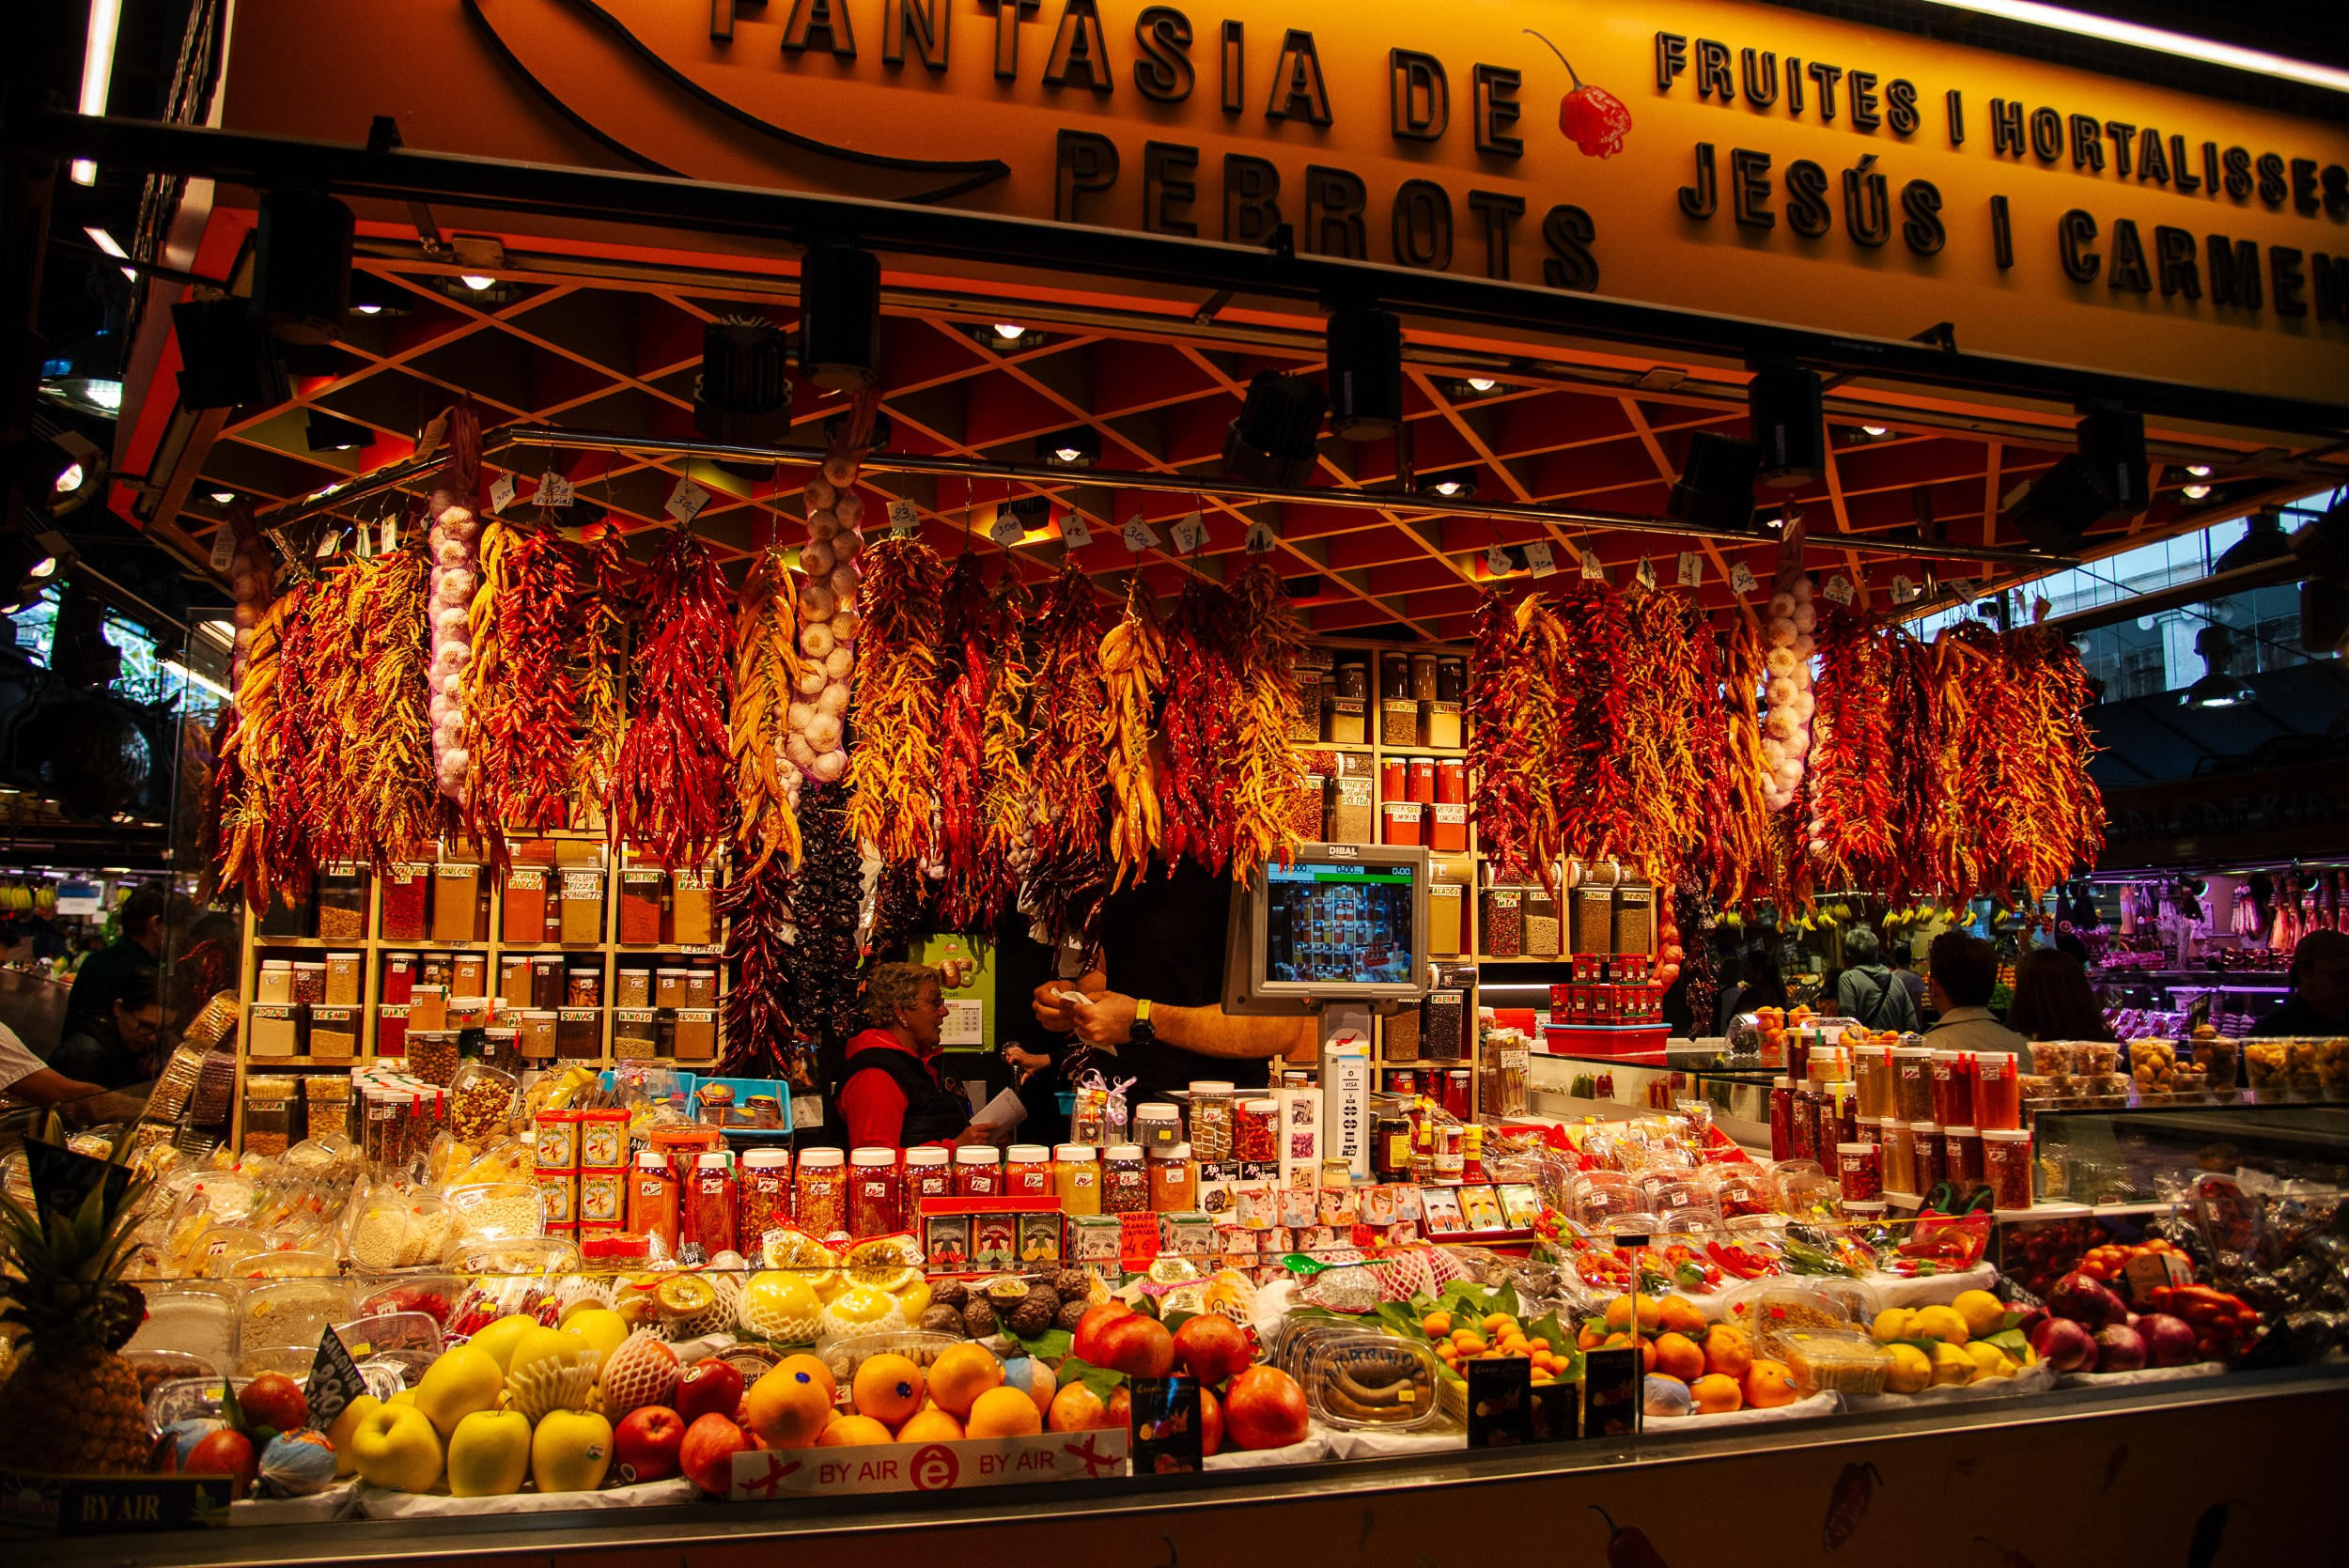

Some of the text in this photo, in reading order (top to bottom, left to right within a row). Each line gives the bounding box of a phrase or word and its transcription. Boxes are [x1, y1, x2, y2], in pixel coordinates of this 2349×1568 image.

[1389, 47, 1524, 158] DE
[1656, 30, 2349, 224] FRUITES I HORTALISSES
[1055, 128, 1598, 293] PEBROTS
[1678, 143, 2349, 325] JESÚS I CARMEN
[1329, 846, 1358, 855] DIBAL
[514, 872, 541, 881] CURRY
[1432, 995, 1460, 1003] ENEBRO
[254, 1007, 287, 1017] MOSTAZA
[315, 1011, 349, 1019] SESAMO
[620, 1013, 650, 1021] HINOJO
[1205, 1164, 1220, 1175] Ajo
[1245, 1164, 1259, 1175] Ajo
[1215, 1173, 1237, 1182] Negro
[1254, 1172, 1277, 1181] Negro
[819, 1463, 851, 1483] BY
[858, 1460, 897, 1482] AIR
[980, 1454, 1011, 1474] BY
[1016, 1451, 1054, 1471] AIR
[82, 1495, 115, 1521] BY
[117, 1494, 161, 1522] AIR
